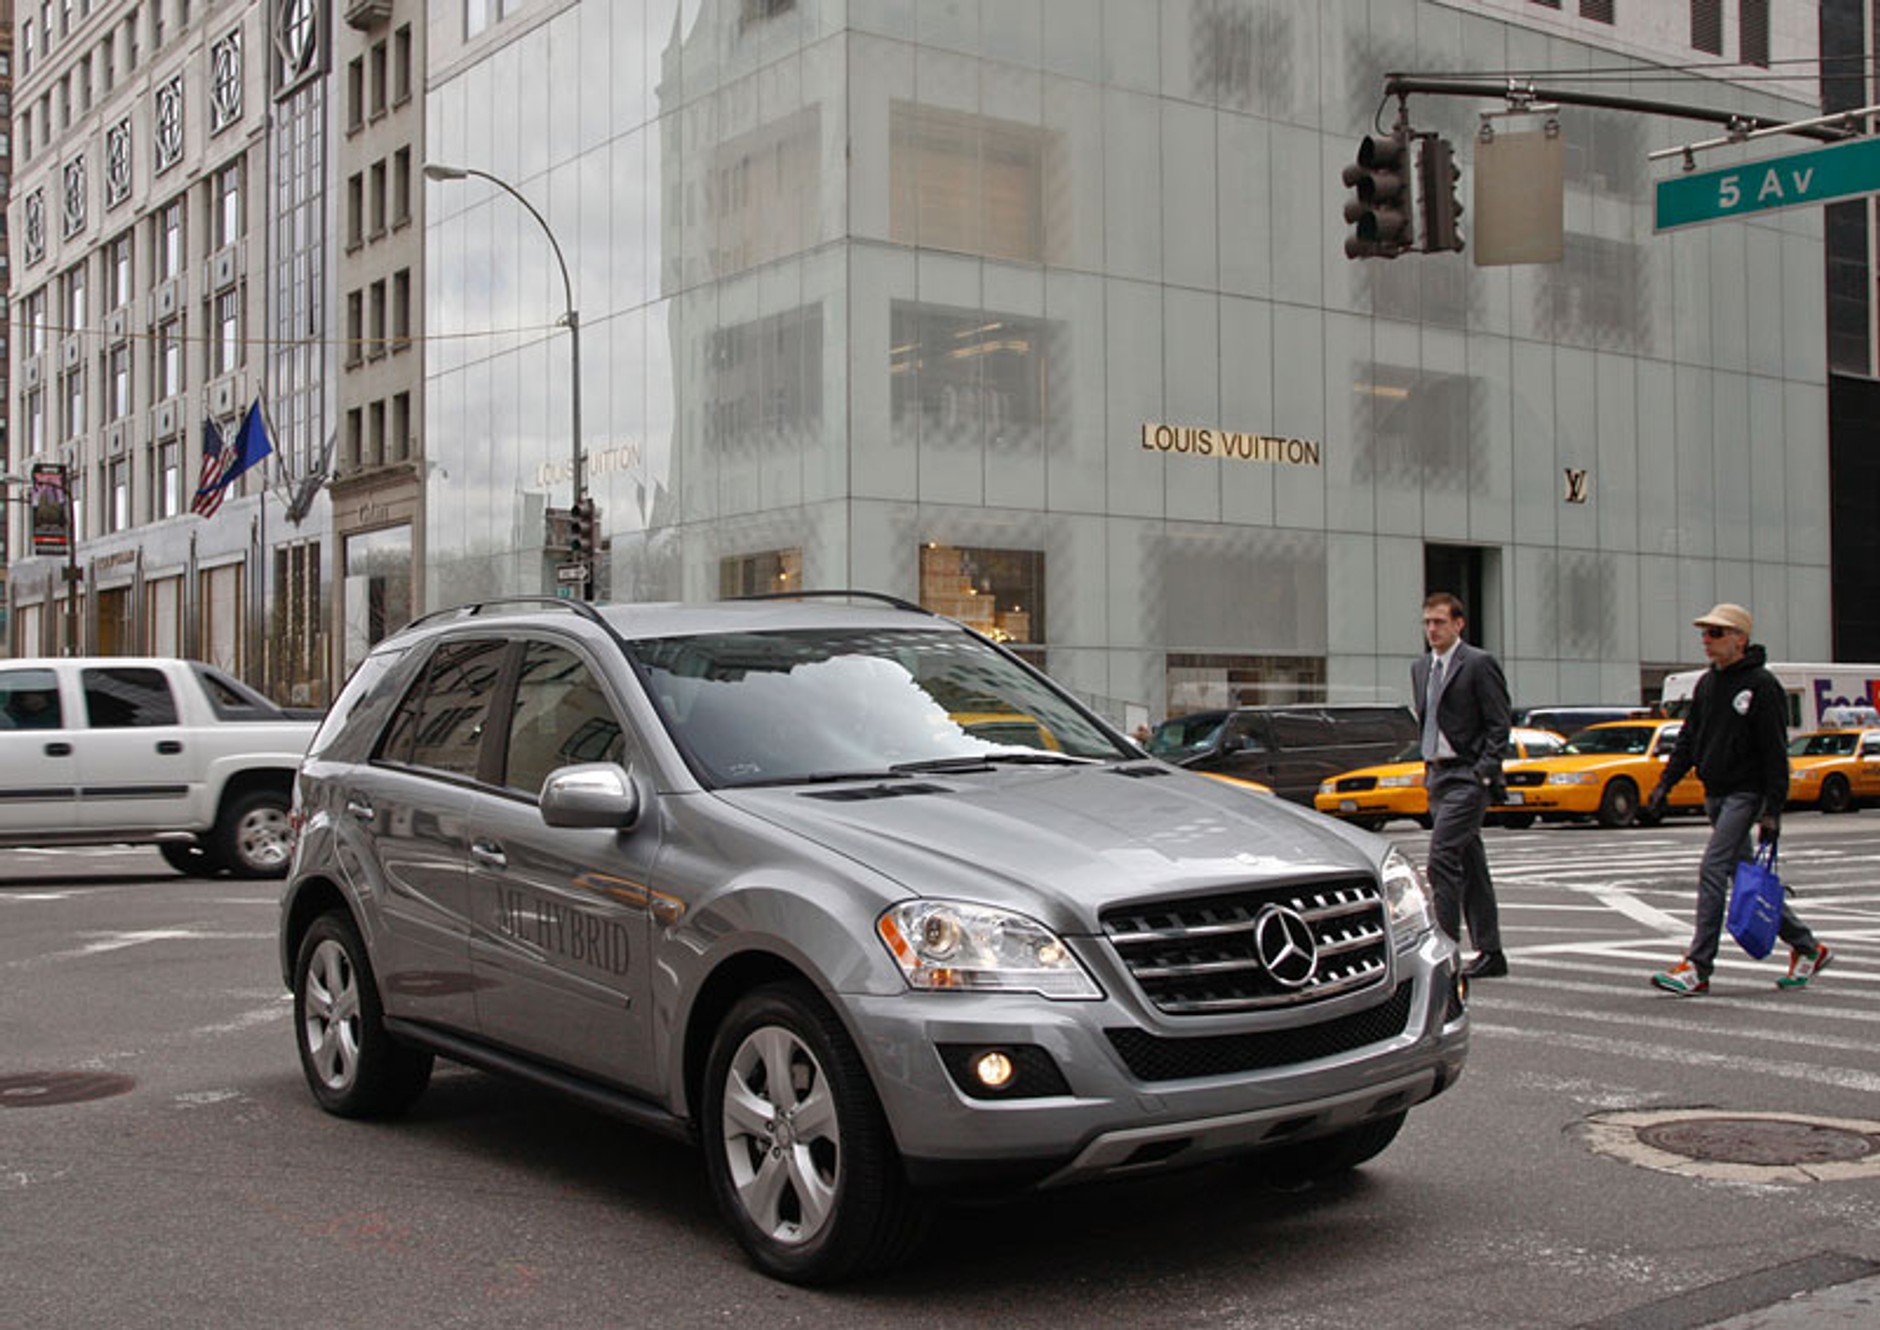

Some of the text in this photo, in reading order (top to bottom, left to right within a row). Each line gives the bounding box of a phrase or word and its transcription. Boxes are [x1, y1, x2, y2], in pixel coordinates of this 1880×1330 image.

[1719, 175, 1741, 208] 5
[584, 442, 640, 476] UITTON
[1142, 423, 1320, 466] LOUIS VUITTON
[497, 882, 629, 976] ML HYBRID
